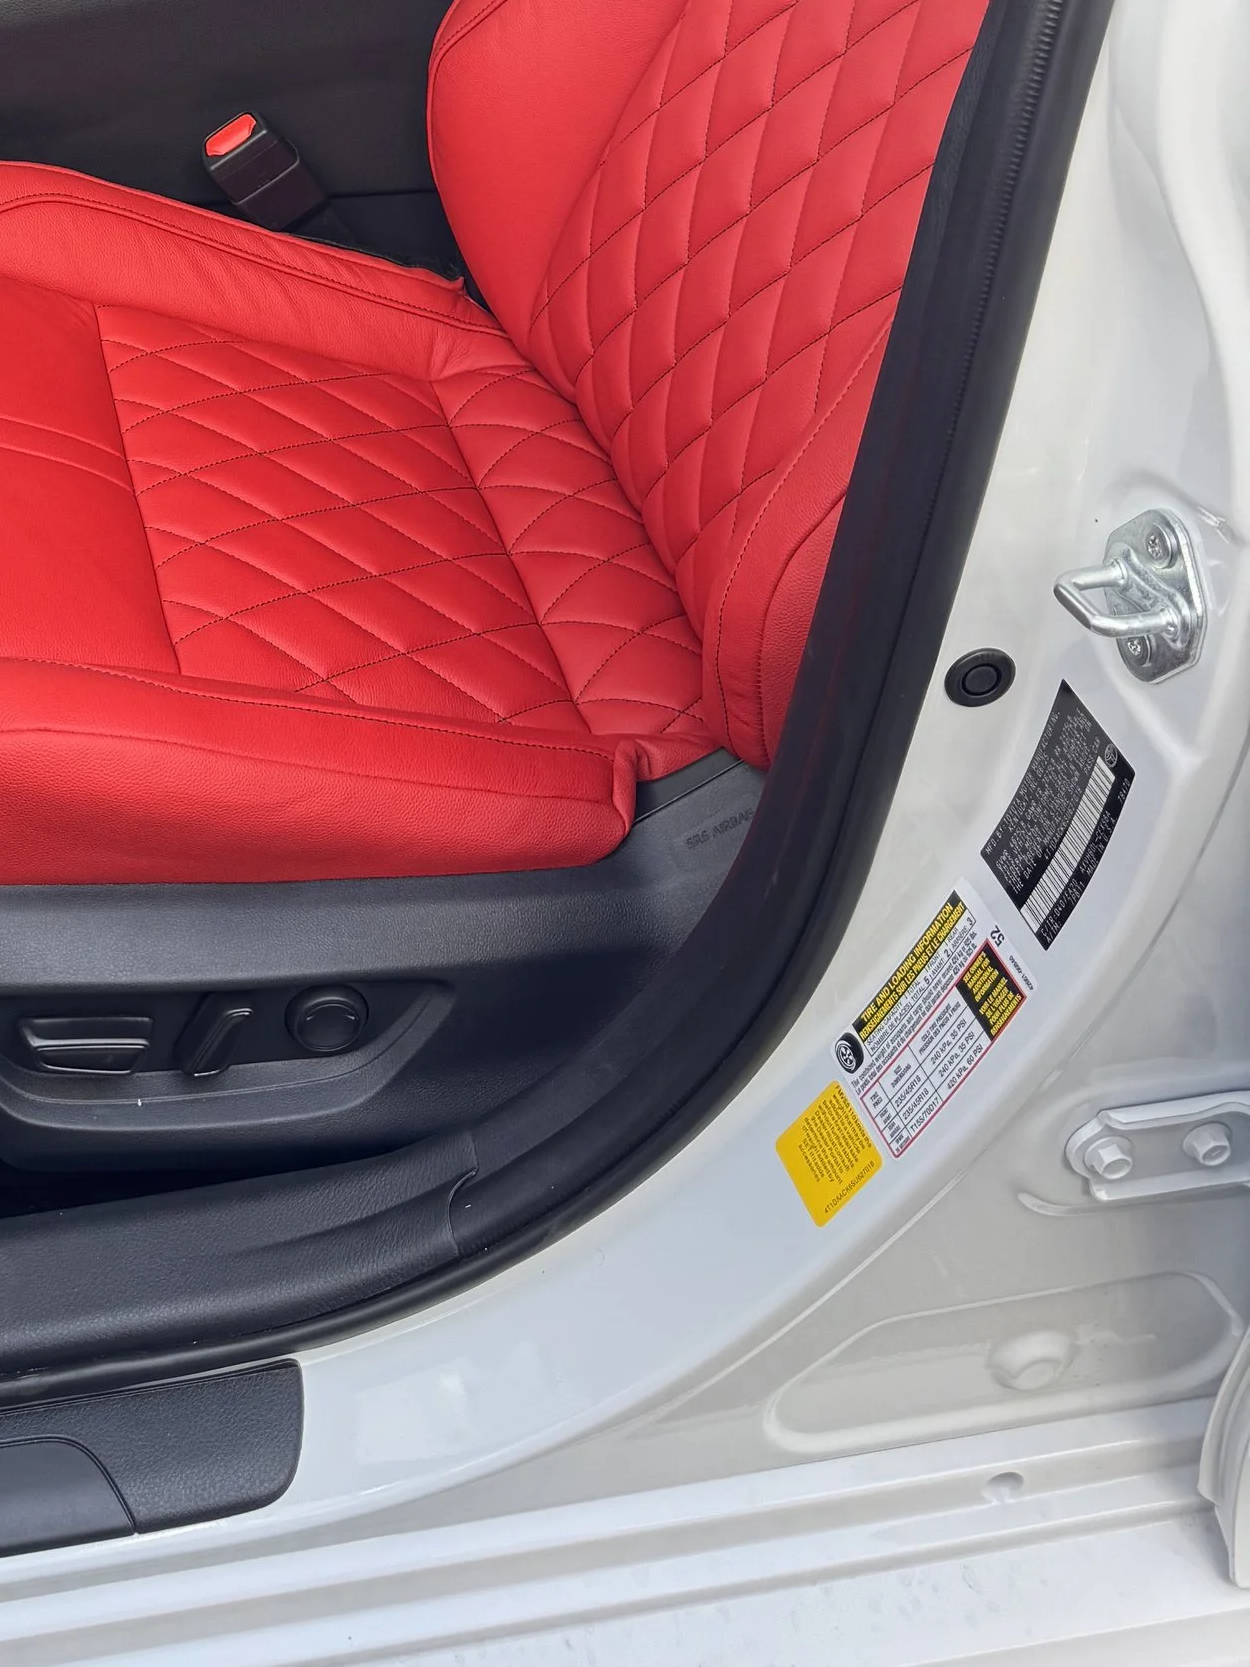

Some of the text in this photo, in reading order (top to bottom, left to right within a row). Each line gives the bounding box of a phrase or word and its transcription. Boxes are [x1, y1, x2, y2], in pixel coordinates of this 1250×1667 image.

[860, 1000, 878, 1025] TIRE
[874, 984, 891, 1007] AND
[887, 951, 917, 991] LOADING
[911, 901, 955, 958] INFORMATION
[989, 924, 1006, 947] 52
[894, 978, 908, 996] SUR
[903, 968, 916, 985] LES
[893, 1072, 922, 1109] 235/45R18
[949, 1028, 959, 1041] 35
[955, 1016, 967, 1032] PSI
[901, 1085, 930, 1121] 235/45R18
[957, 1040, 967, 1053] 35
[963, 1029, 976, 1045] PSI
[909, 1094, 940, 1134] T155/70D17
[965, 1053, 975, 1066] 60
[972, 1042, 984, 1058] PSI
